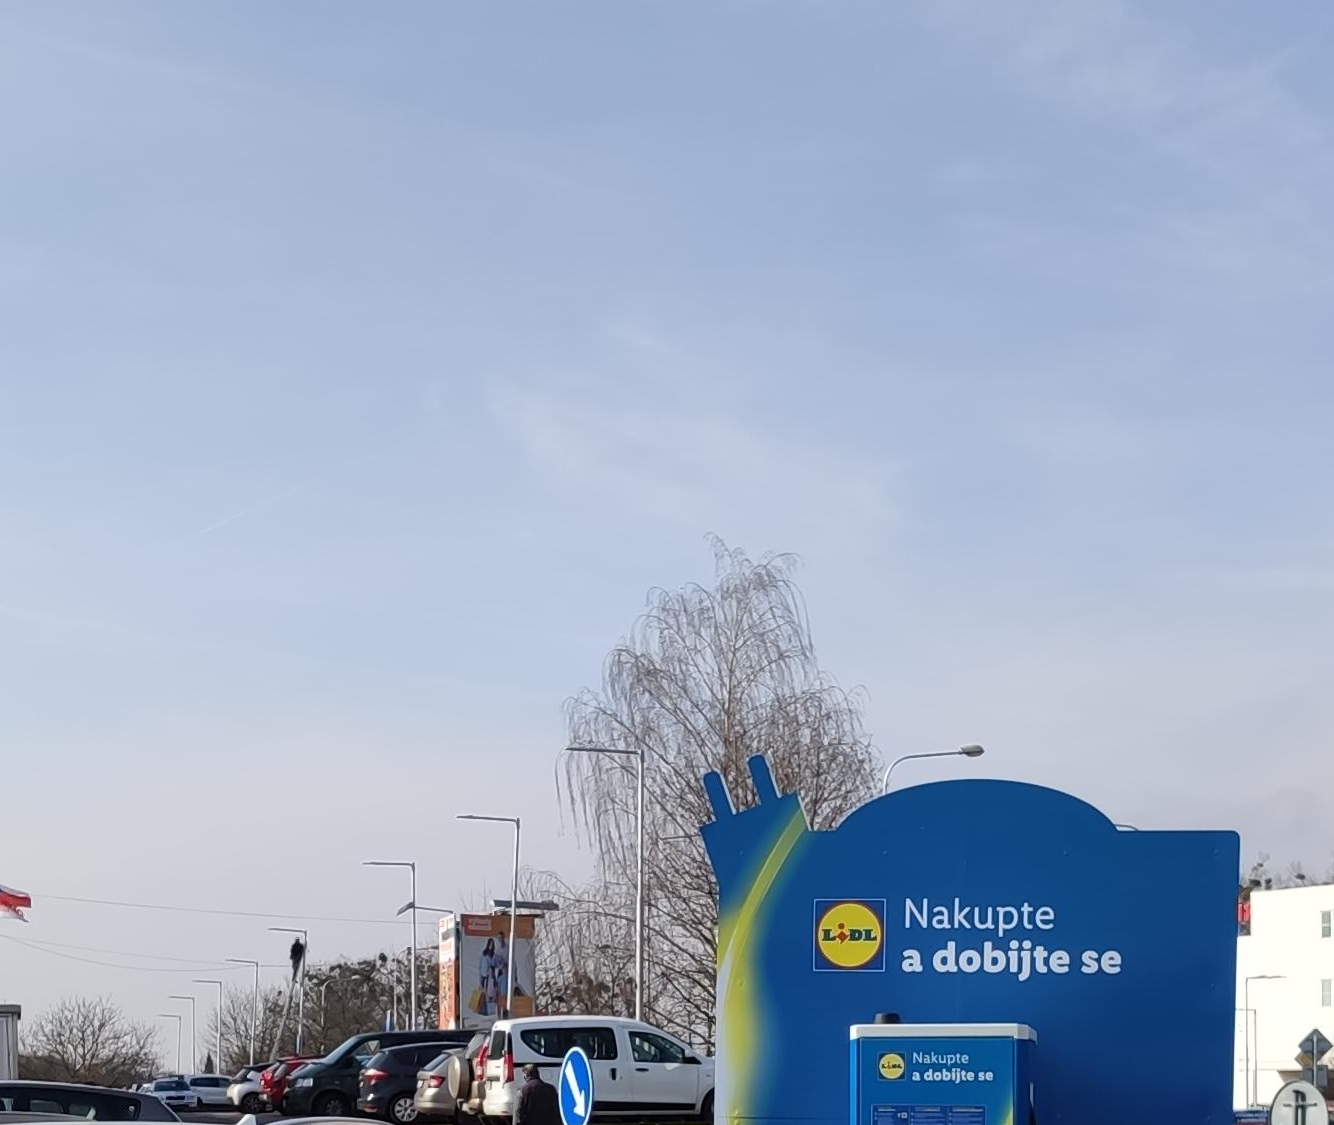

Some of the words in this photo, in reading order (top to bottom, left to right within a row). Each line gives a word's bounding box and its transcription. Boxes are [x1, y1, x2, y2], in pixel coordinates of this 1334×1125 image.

[904, 898, 1055, 937] Nakupte
[901, 949, 923, 973] a
[932, 940, 1070, 982] dobijte
[1080, 949, 1122, 974] se
[912, 1052, 969, 1066] Nakupte
[911, 1071, 921, 1081] a
[923, 1068, 974, 1084] dobijte
[978, 1071, 994, 1081] se
